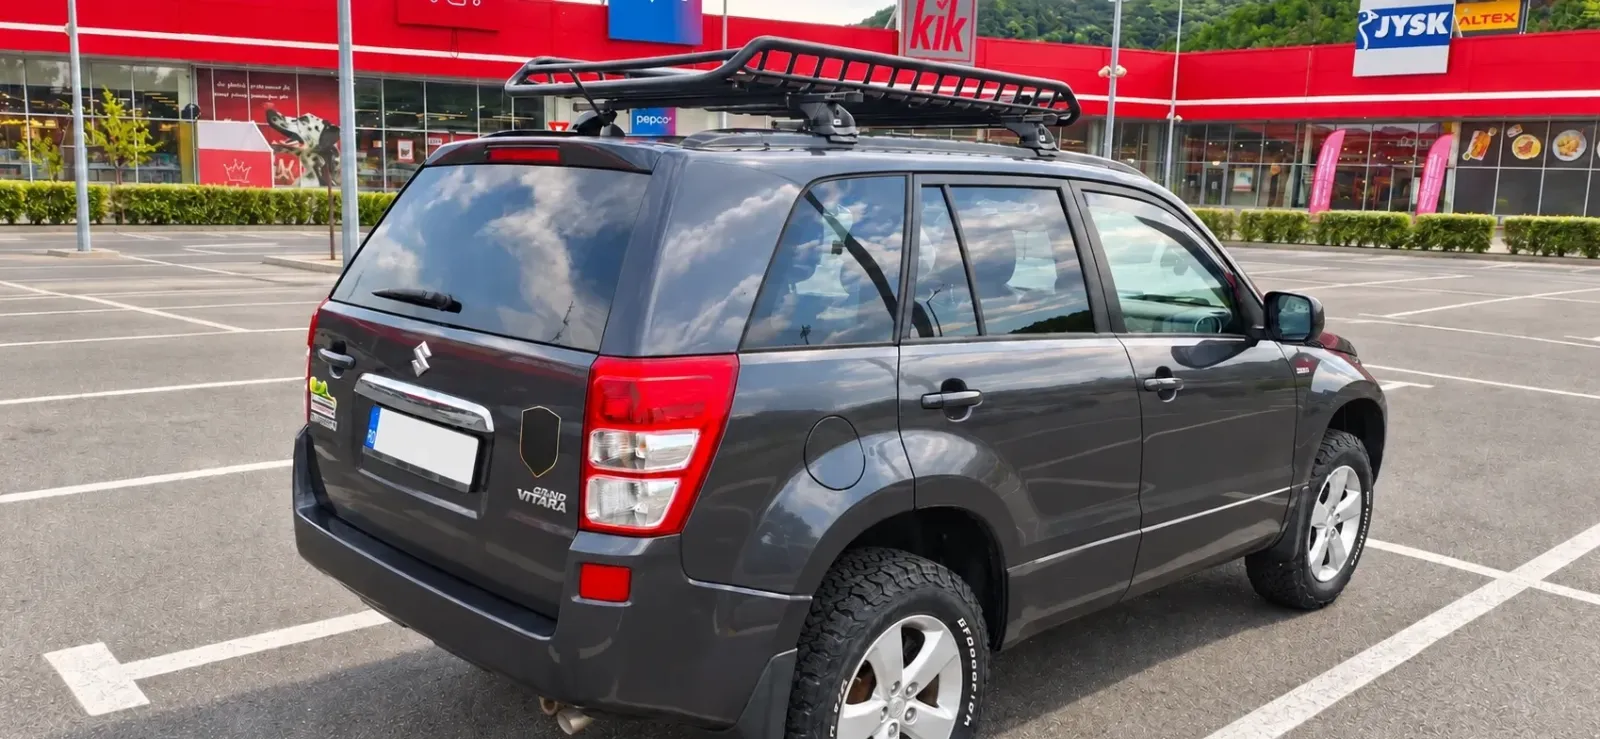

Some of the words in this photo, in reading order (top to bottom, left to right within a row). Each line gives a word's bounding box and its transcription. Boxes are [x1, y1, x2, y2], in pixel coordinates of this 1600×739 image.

[1374, 12, 1449, 38] JYSK
[1459, 13, 1516, 25] ALTEX
[636, 115, 669, 125] pepco
[517, 488, 567, 513] VITARA
